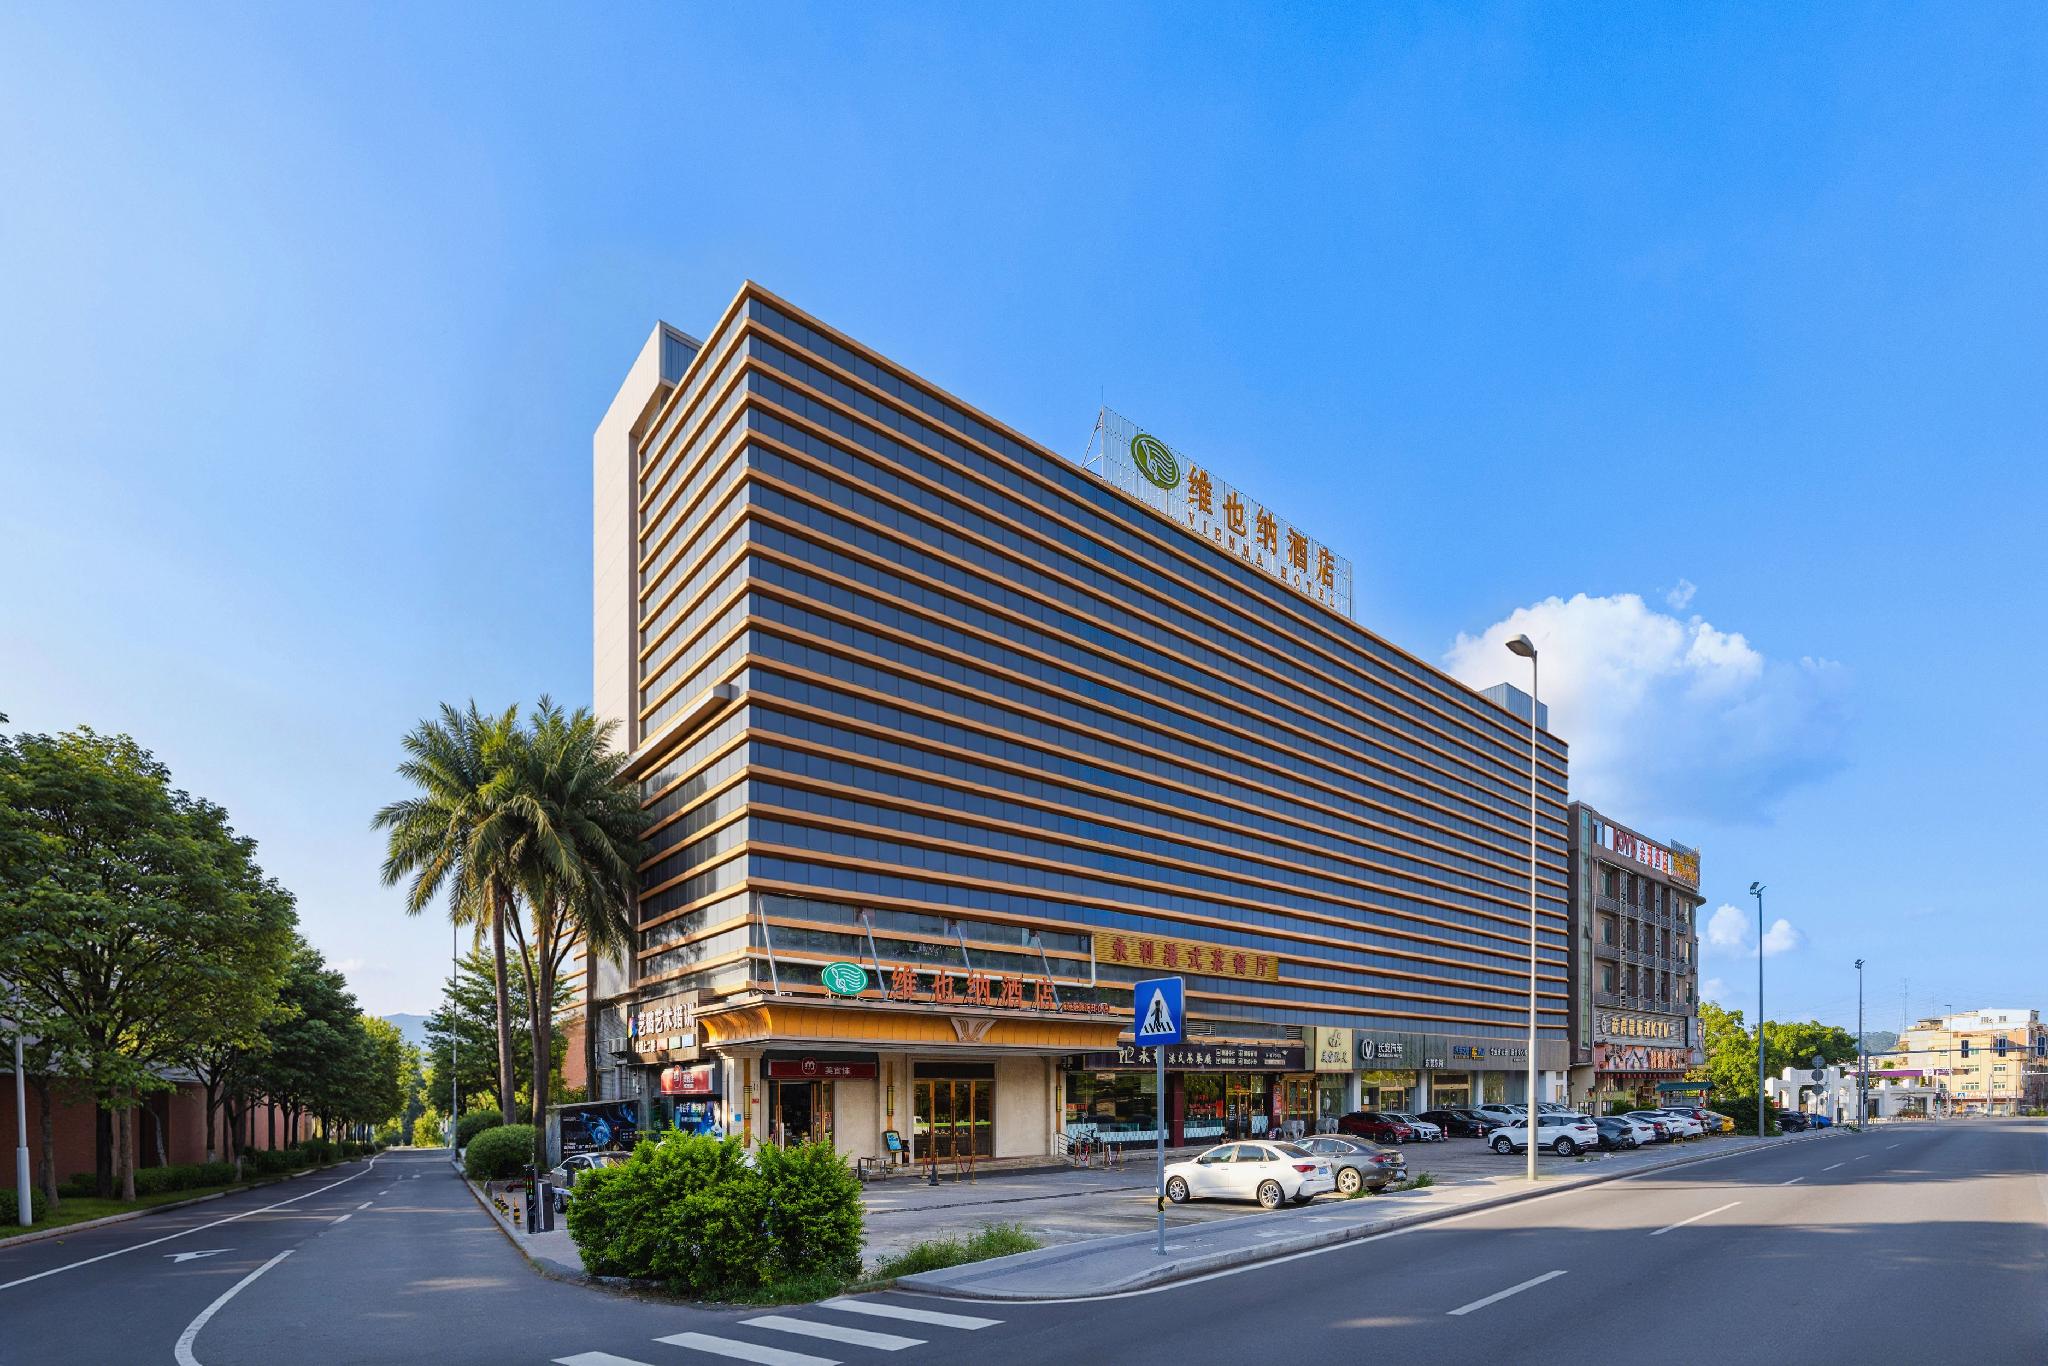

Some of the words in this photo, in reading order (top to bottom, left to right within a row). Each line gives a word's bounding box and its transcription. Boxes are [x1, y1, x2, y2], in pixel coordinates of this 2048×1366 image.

[1187, 463, 1335, 590] 维也纳酒店
[1188, 511, 1264, 567] VIENNA
[1281, 566, 1335, 608] HOTEL
[891, 965, 1055, 1008] 维也纳酒店
[1112, 936, 1268, 976] 永利港式茶餐厅
